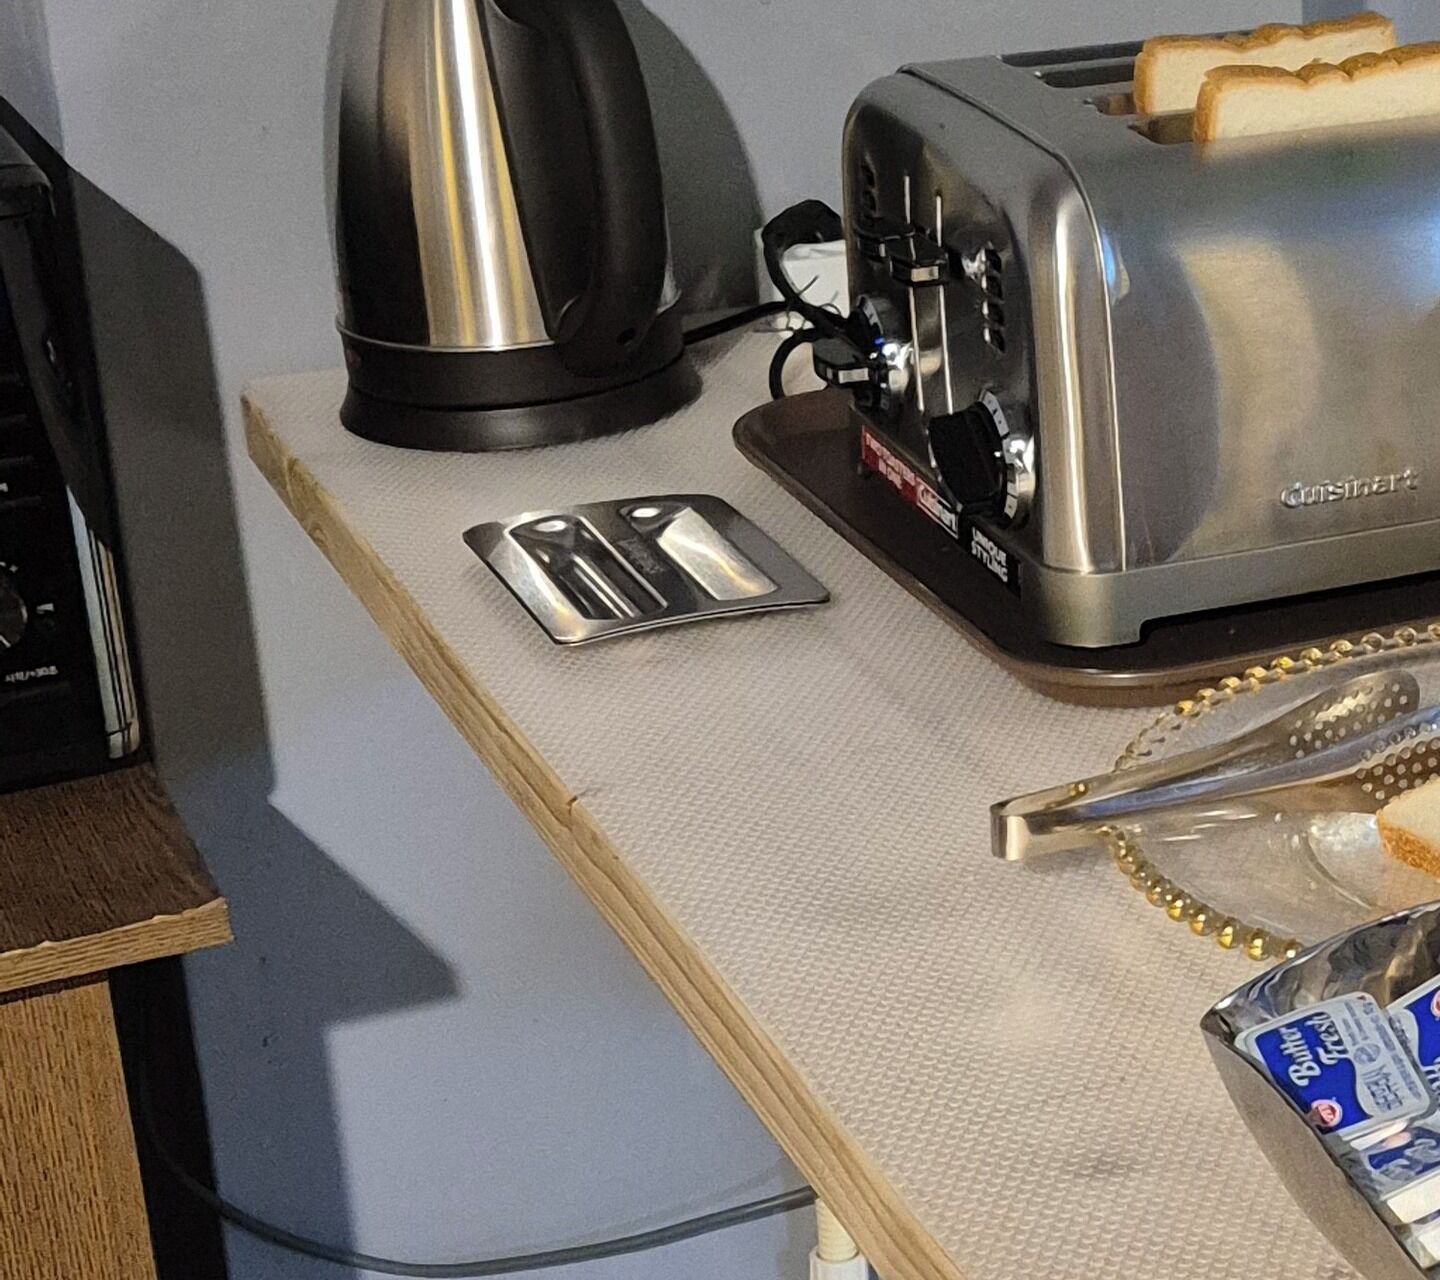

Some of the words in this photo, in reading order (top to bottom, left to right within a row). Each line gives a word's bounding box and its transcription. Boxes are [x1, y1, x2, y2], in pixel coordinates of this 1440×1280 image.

[1279, 468, 1420, 509] Cuisinart
[971, 540, 1008, 583] STYLING
[972, 526, 1007, 567] UNIQUE
[1279, 1027, 1321, 1087] Butter
[1304, 1011, 1350, 1065] Fresh
